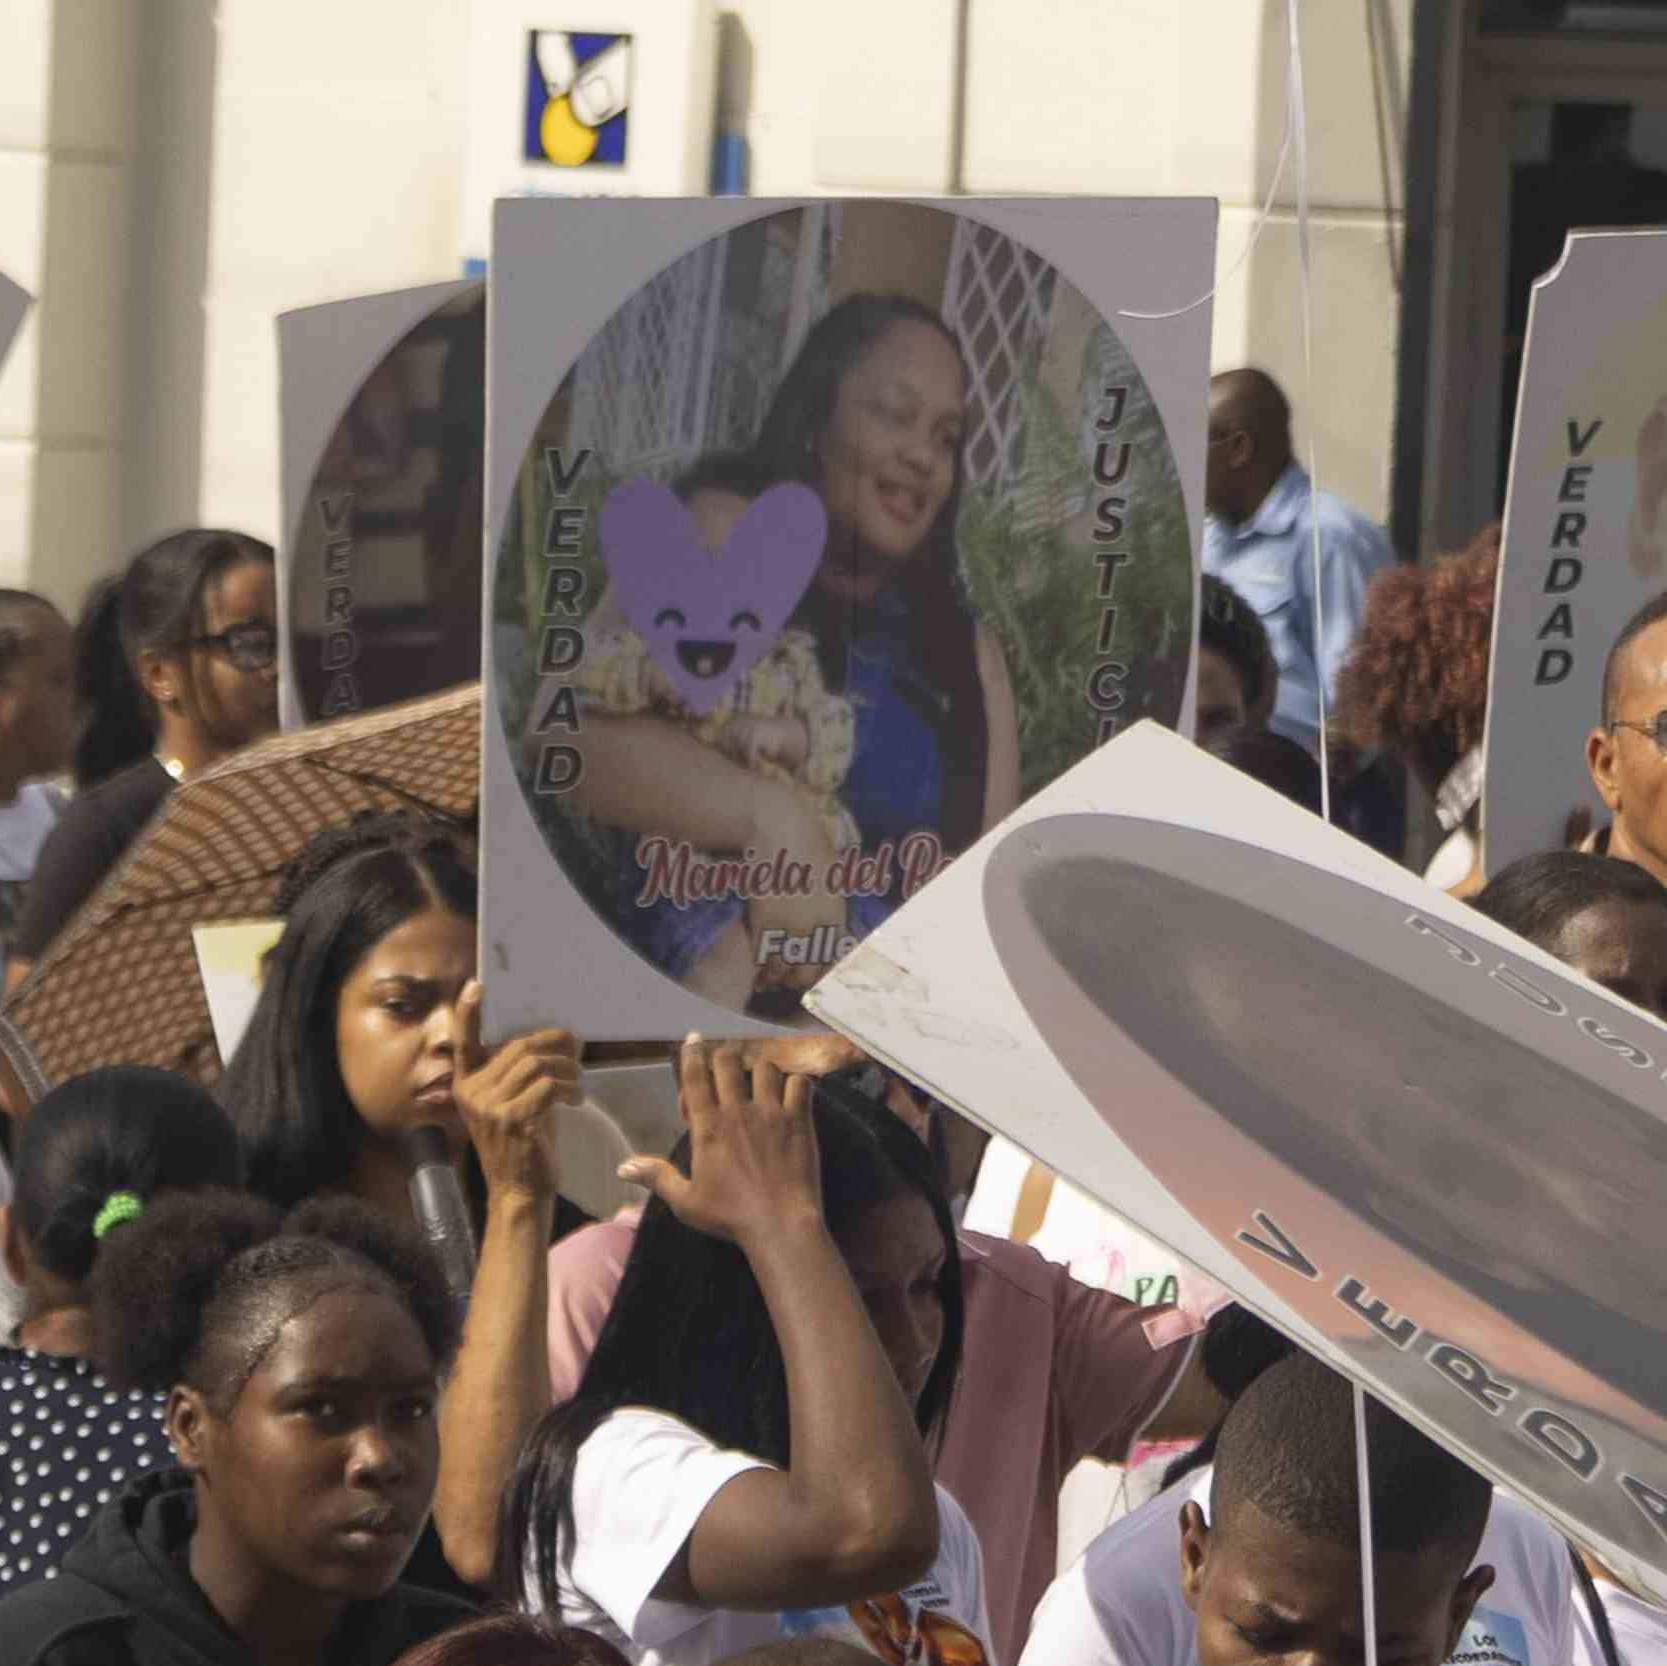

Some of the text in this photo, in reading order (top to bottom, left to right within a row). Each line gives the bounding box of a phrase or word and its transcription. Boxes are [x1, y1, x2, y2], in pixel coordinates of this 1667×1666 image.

[315, 489, 359, 717] VERDA
[534, 446, 593, 796] VERDAD
[1534, 419, 1604, 687] VERDAD
[634, 834, 816, 912] Mariela
[824, 842, 893, 899] del
